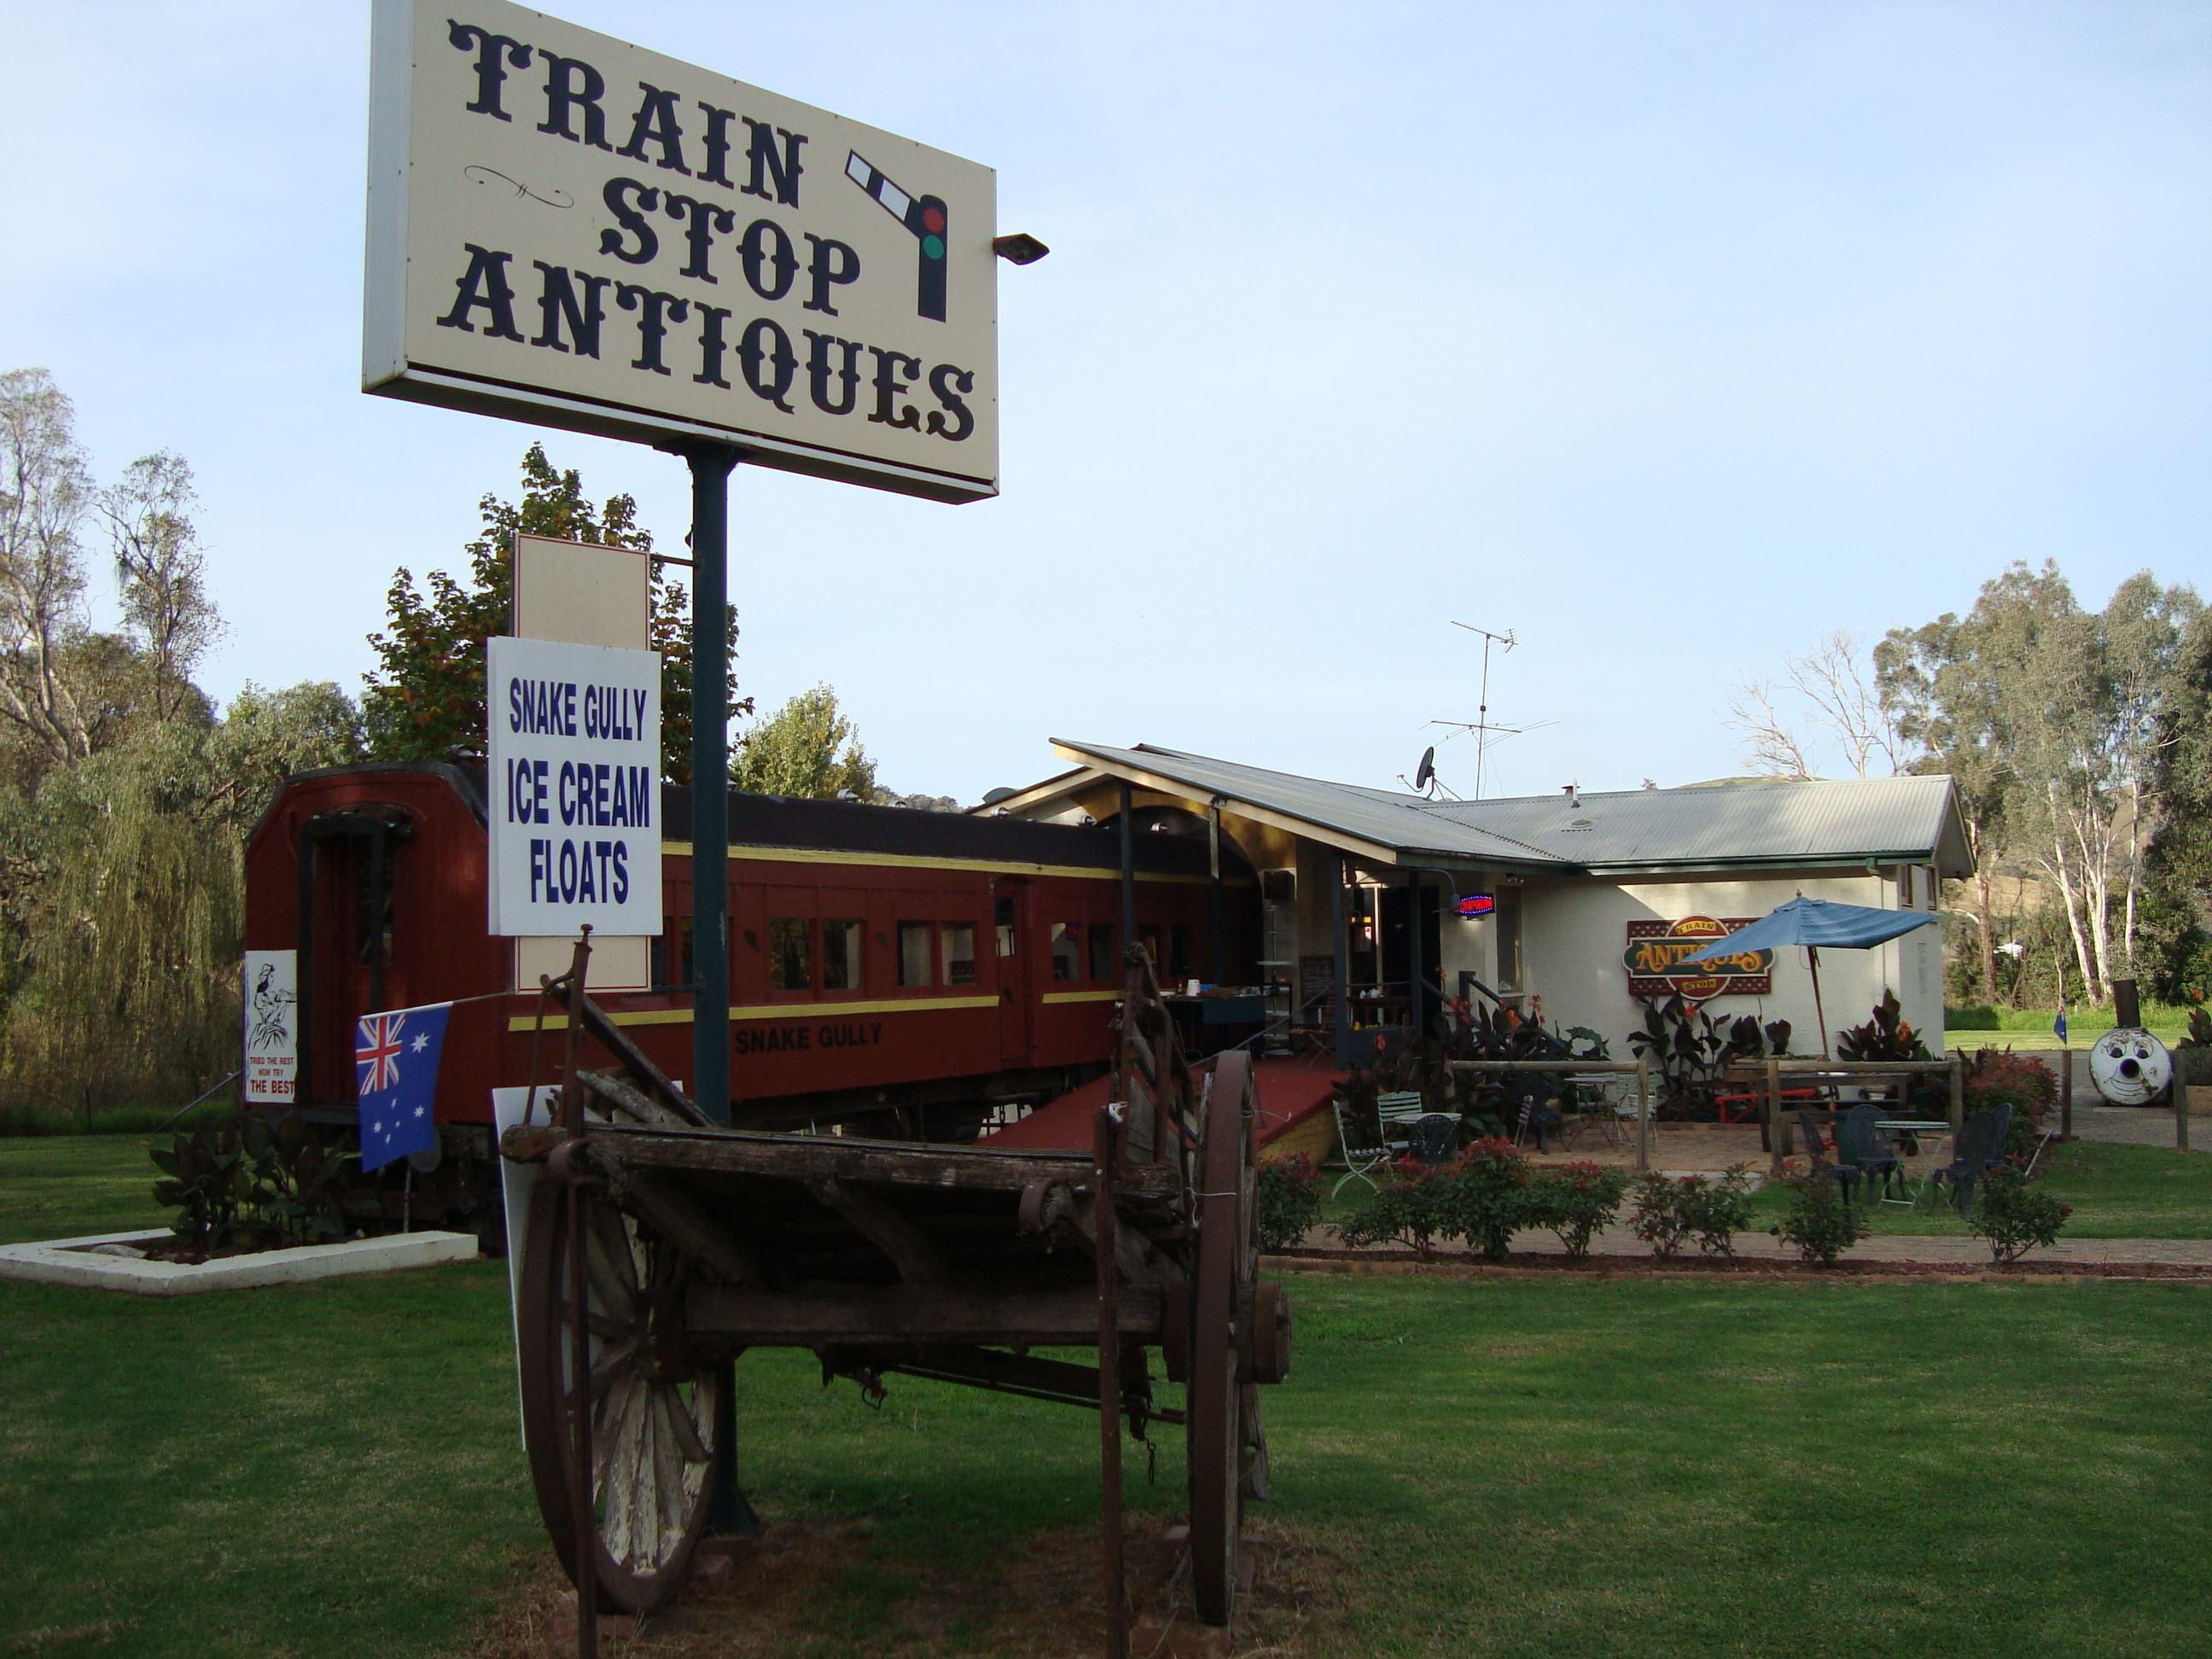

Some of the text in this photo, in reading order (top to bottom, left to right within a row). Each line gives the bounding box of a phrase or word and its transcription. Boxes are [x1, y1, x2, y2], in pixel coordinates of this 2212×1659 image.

[446, 19, 809, 210] TRAIN
[598, 177, 861, 317] STOP
[436, 242, 975, 442] ANTIQUES
[509, 677, 647, 742] SNAKE GULLY
[508, 758, 650, 828] ICE CREAM
[531, 838, 629, 905] FLOATS
[1677, 922, 1714, 934] TRAIN
[1685, 981, 1714, 990] STOP
[736, 1023, 882, 1055] SNAKE GULLY
[250, 1080, 295, 1094] THE BEST
